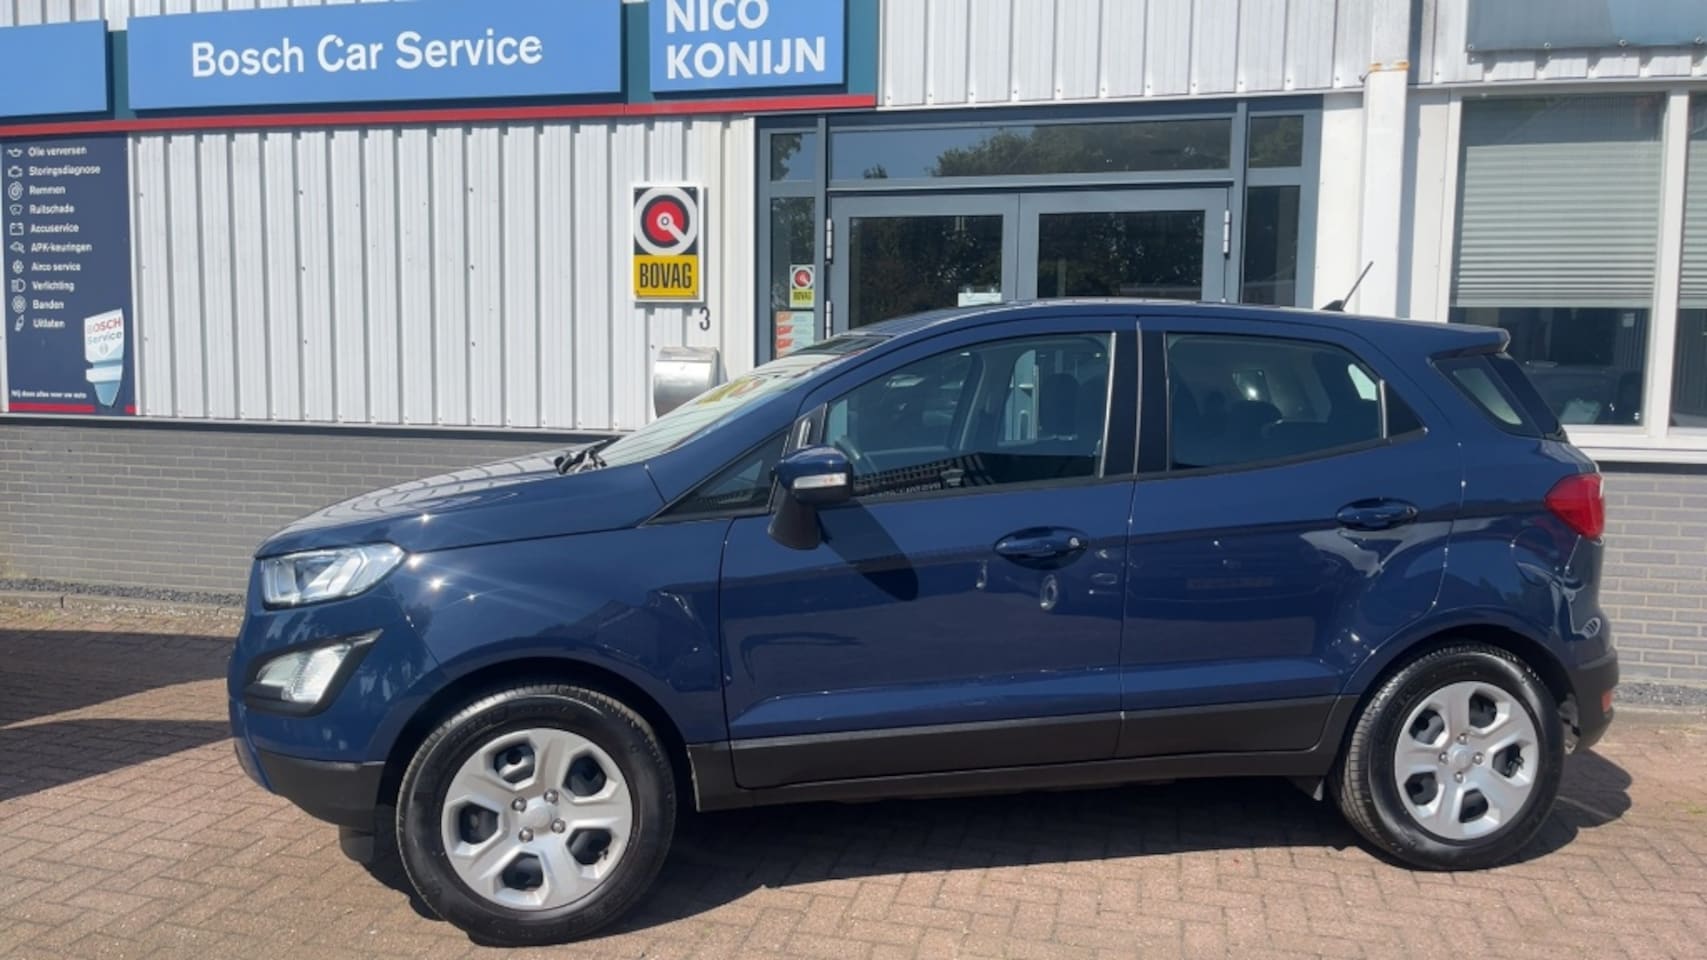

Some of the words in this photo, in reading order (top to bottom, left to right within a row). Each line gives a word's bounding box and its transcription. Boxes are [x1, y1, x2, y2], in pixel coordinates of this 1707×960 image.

[666, 0, 769, 33] NICO
[192, 38, 304, 77] Bosch
[317, 34, 383, 72] Car
[395, 28, 543, 69] Service
[667, 36, 825, 80] KONIJN
[28, 147, 45, 157] Olie
[46, 146, 87, 156] verversen
[29, 165, 101, 177] Storingsdiagnose
[29, 185, 66, 195] Remmen
[29, 203, 75, 214] Ruitschade
[30, 223, 80, 233] Accuservice
[31, 242, 92, 253] APK-keuringen
[31, 262, 52, 271] Airco
[53, 262, 81, 271] service
[639, 262, 692, 289] BOVAG
[31, 281, 75, 293] Verlichting
[32, 299, 65, 309] Banden
[32, 318, 66, 328] Uitlaten
[699, 306, 711, 331] 3
